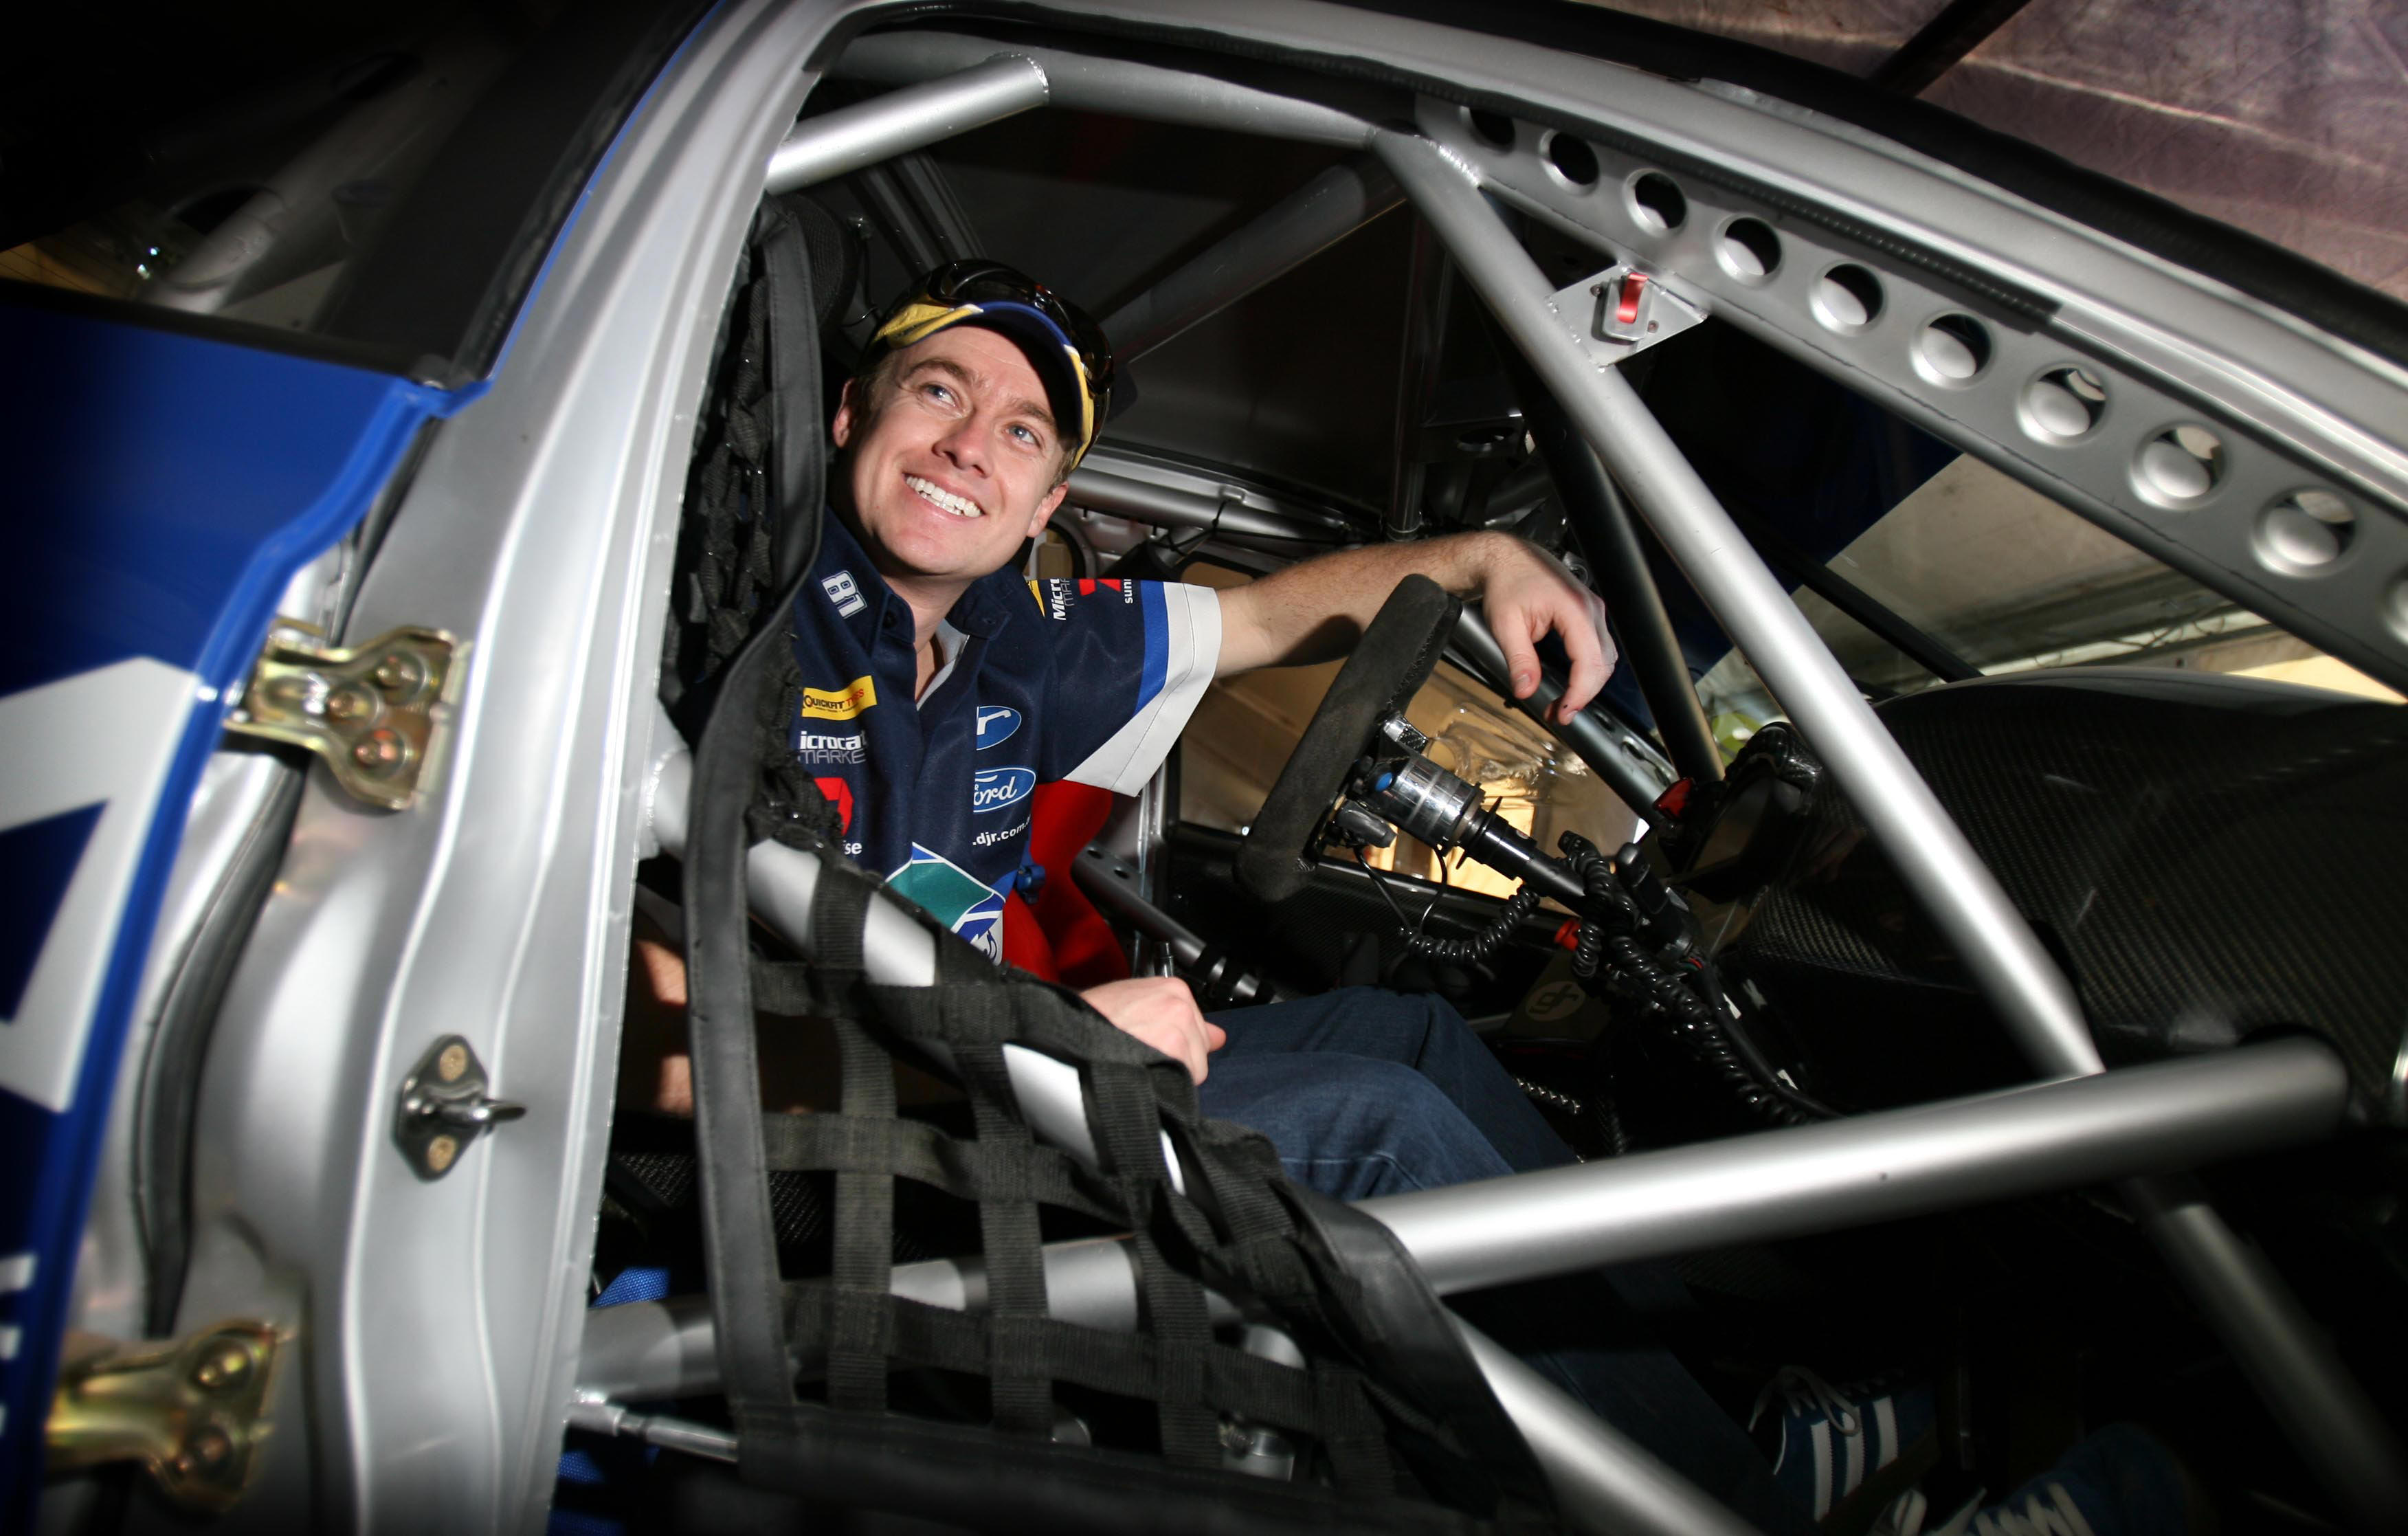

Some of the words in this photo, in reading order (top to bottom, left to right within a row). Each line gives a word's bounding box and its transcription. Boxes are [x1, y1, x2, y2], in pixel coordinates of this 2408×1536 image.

[821, 570, 867, 619] 81
[1124, 579, 1133, 604] sun
[843, 840, 862, 855] se
